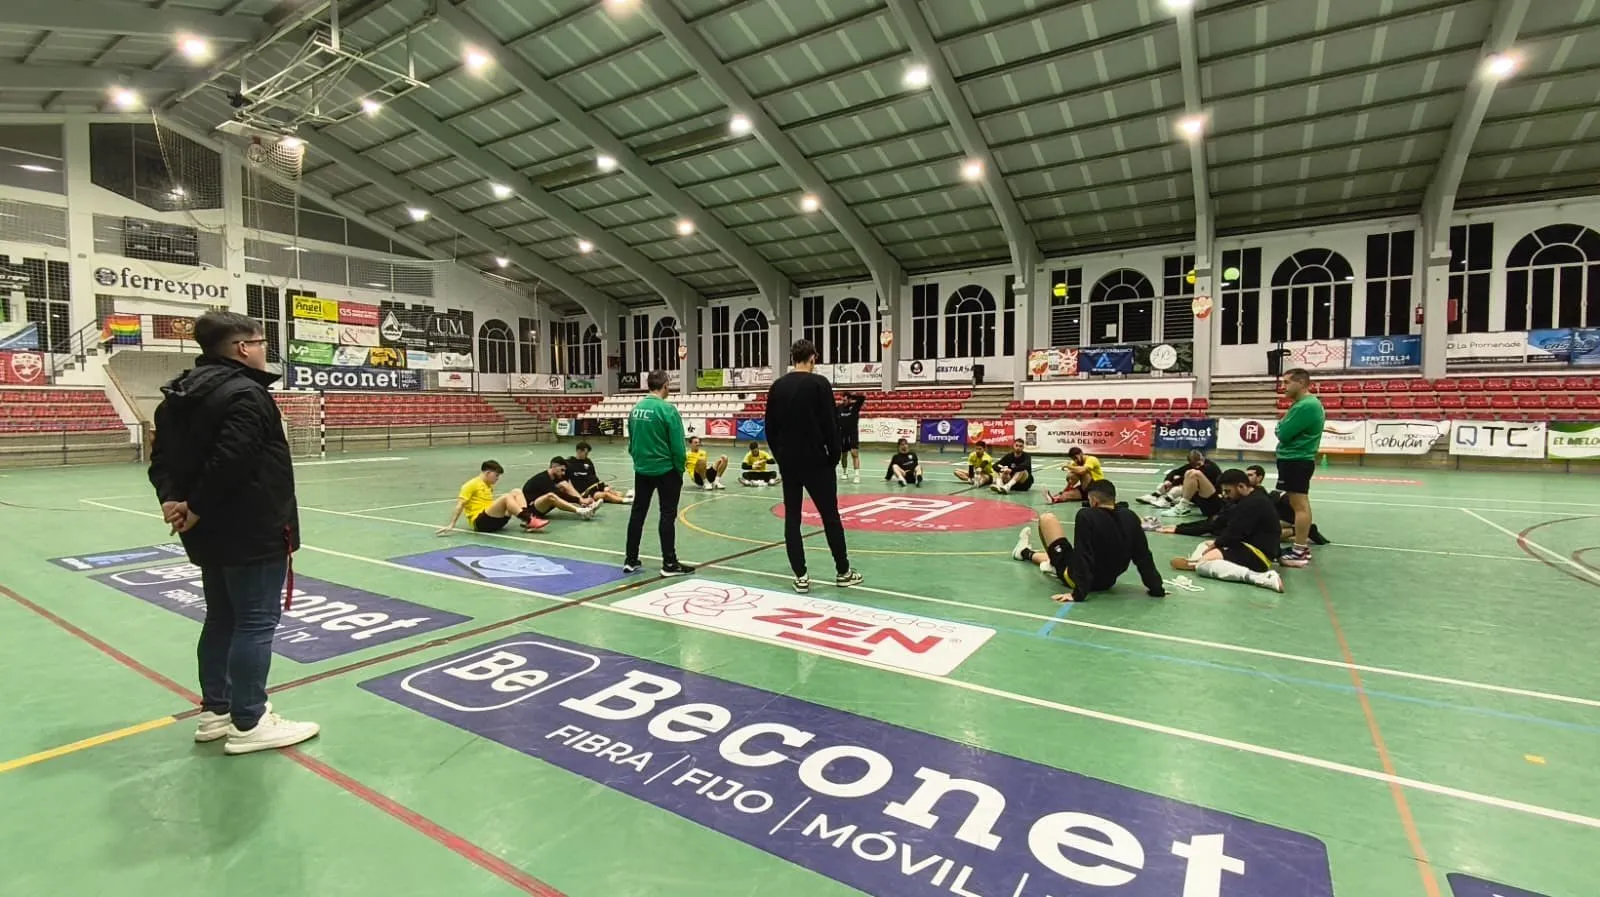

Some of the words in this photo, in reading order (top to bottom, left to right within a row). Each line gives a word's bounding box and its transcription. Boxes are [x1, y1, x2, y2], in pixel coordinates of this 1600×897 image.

[121, 267, 229, 300] ferrexpor
[435, 317, 465, 336] UM
[1469, 341, 1521, 349] Promenade
[294, 366, 399, 387] Beconet
[1159, 426, 1212, 437] Beconet
[1456, 425, 1529, 447] QTC
[751, 607, 943, 655] ZEN
[442, 651, 549, 693] Be
[559, 670, 1246, 897] Beconet
[545, 724, 654, 773] FIBRA
[671, 768, 774, 814] FIJO
[801, 813, 987, 897] MÓVIL
